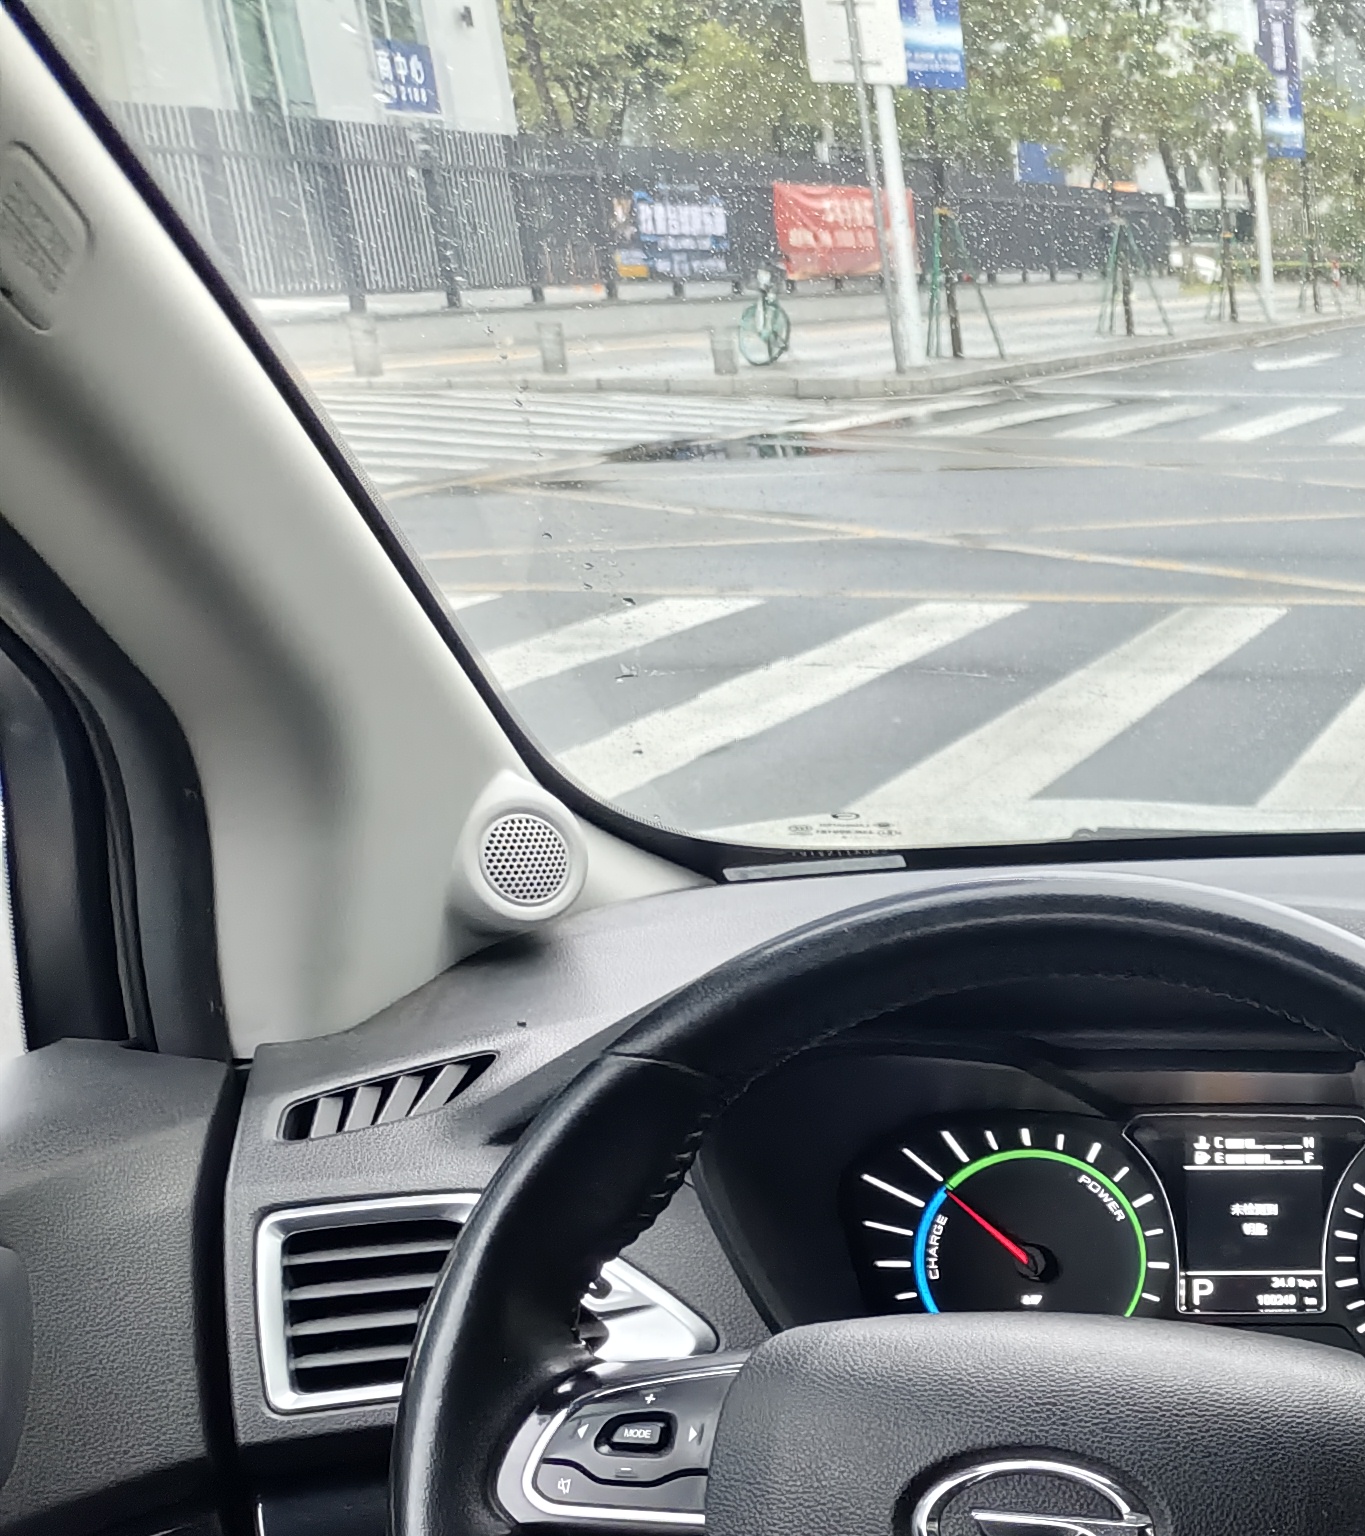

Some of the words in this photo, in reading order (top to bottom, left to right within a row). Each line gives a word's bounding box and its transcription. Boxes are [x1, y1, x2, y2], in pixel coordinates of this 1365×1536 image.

[1213, 1152, 1224, 1164] E
[1303, 1152, 1315, 1164] F
[1077, 1174, 1126, 1222] POWER
[925, 1214, 949, 1280] CHARGE
[1192, 1278, 1214, 1306] P
[623, 1427, 652, 1440] MODE
